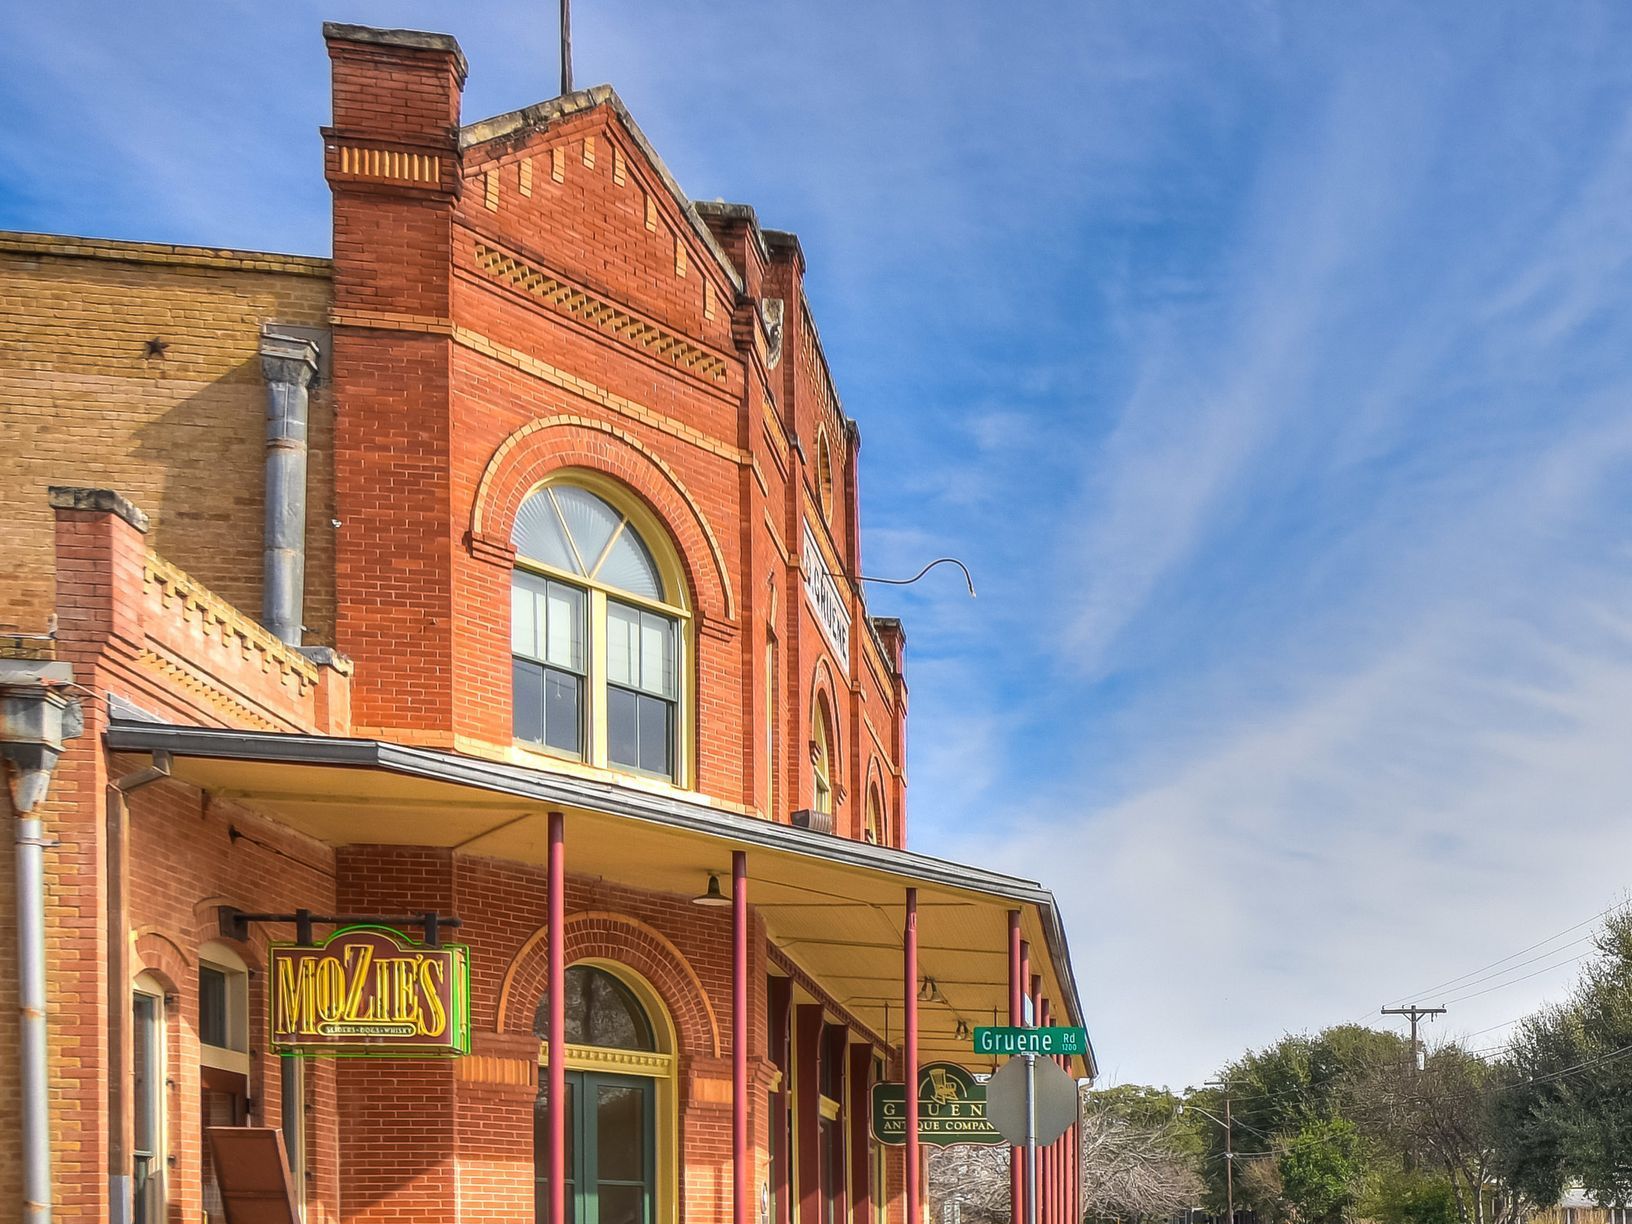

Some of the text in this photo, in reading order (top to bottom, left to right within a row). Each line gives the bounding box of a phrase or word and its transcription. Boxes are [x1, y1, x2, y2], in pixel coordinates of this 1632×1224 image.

[814, 566, 847, 660] GRUENE
[360, 1026, 380, 1034] DOGS
[981, 1030, 1076, 1051] Gruene Rd
[883, 1103, 983, 1116] GUEN
[883, 1121, 995, 1131] ANTQUE COMPAN
